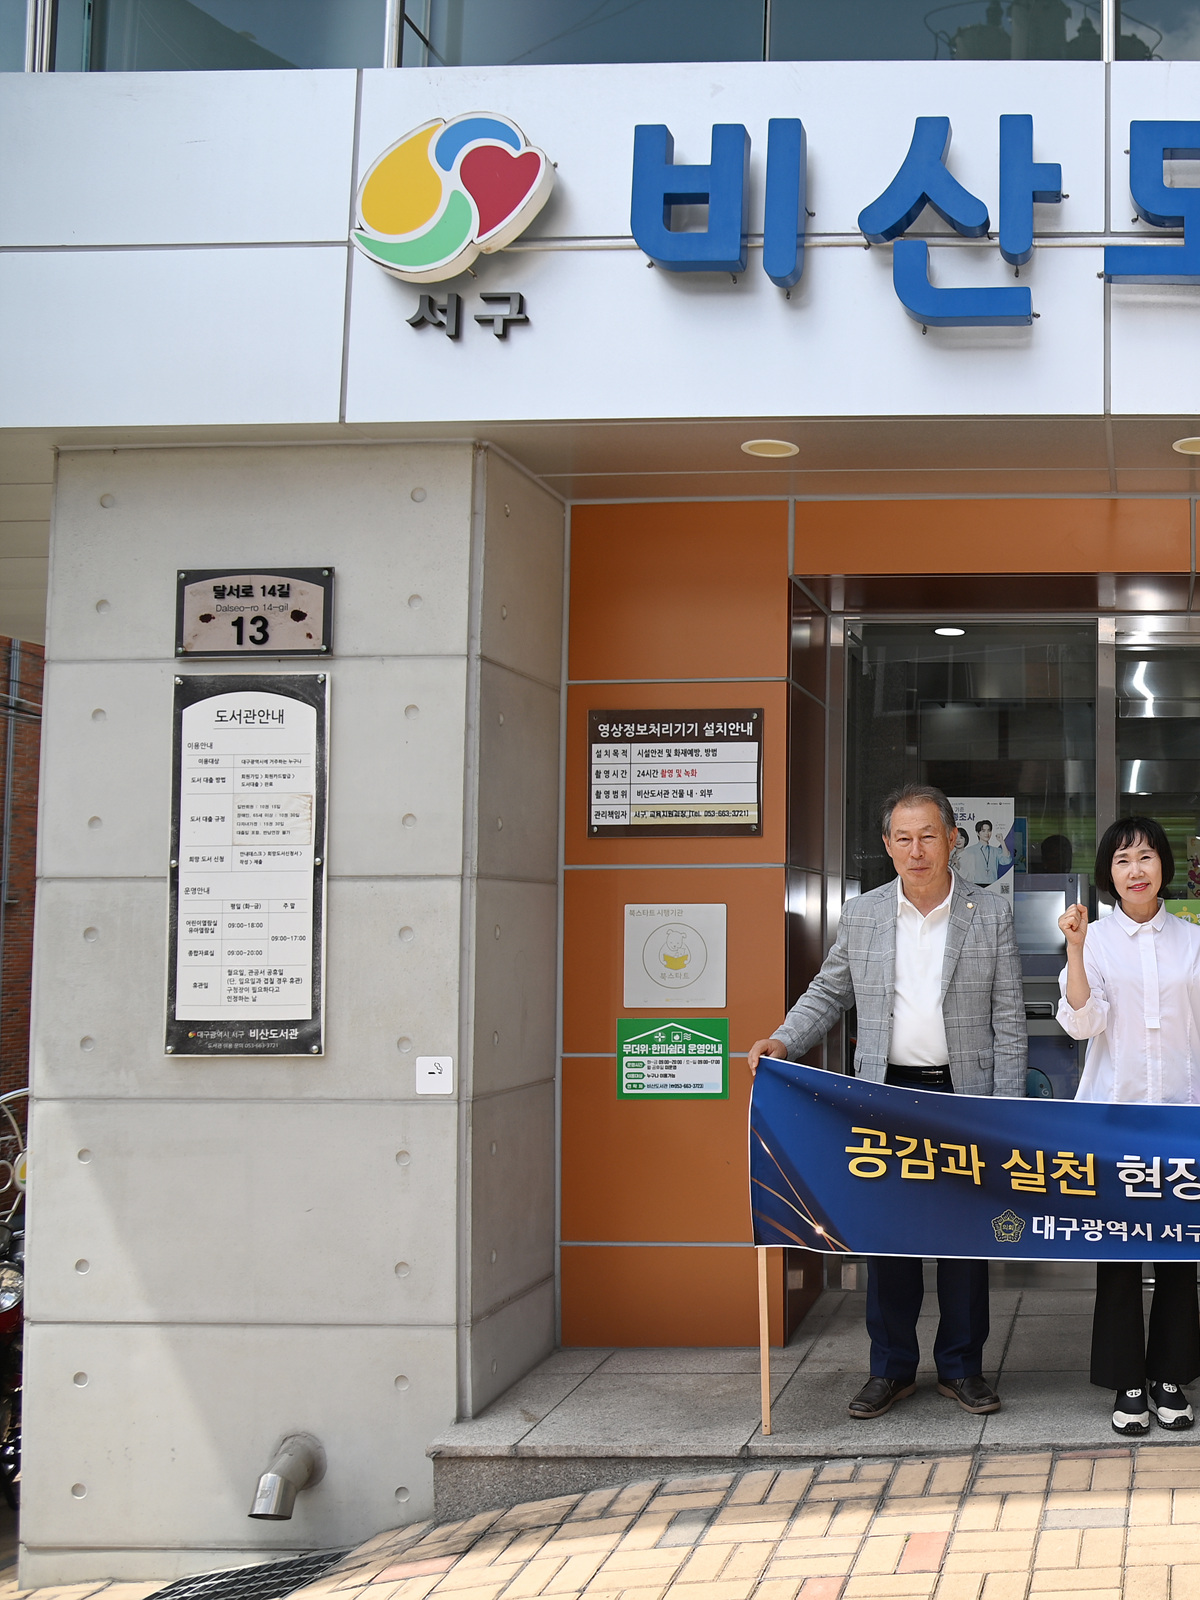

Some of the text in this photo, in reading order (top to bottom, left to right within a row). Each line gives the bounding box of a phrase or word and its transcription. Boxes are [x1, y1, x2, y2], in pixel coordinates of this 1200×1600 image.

[405, 291, 530, 340] 서구
[213, 584, 290, 599] 달서로 14길
[216, 603, 289, 612] Dalseo-ro 14-gil
[231, 615, 270, 646] 13
[214, 709, 285, 724] 도서관안내
[598, 722, 754, 738] 영상정보처리기기 설치안내
[187, 742, 214, 750] 이용안내
[636, 749, 664, 758] 시설안전
[665, 748, 672, 758] 및
[704, 748, 718, 758] 방범
[636, 770, 659, 778] 24시간
[660, 768, 674, 778] 촬영
[675, 768, 682, 778] 및
[684, 768, 698, 778] 녹화
[636, 790, 670, 799] 비산도서관
[671, 789, 685, 798] 건물
[593, 810, 628, 820] 관리책임자
[184, 887, 210, 895] 운영안내
[629, 909, 684, 917] 북스타트 시행기관
[660, 972, 690, 980] 북스타트
[197, 1028, 299, 1040] 대구광역시 서구 비산도서관
[688, 1044, 722, 1054] 운영안내
[845, 1126, 986, 1187] 공감과
[1001, 1149, 1097, 1197] 실천
[1032, 1215, 1153, 1242] 대구광역시
